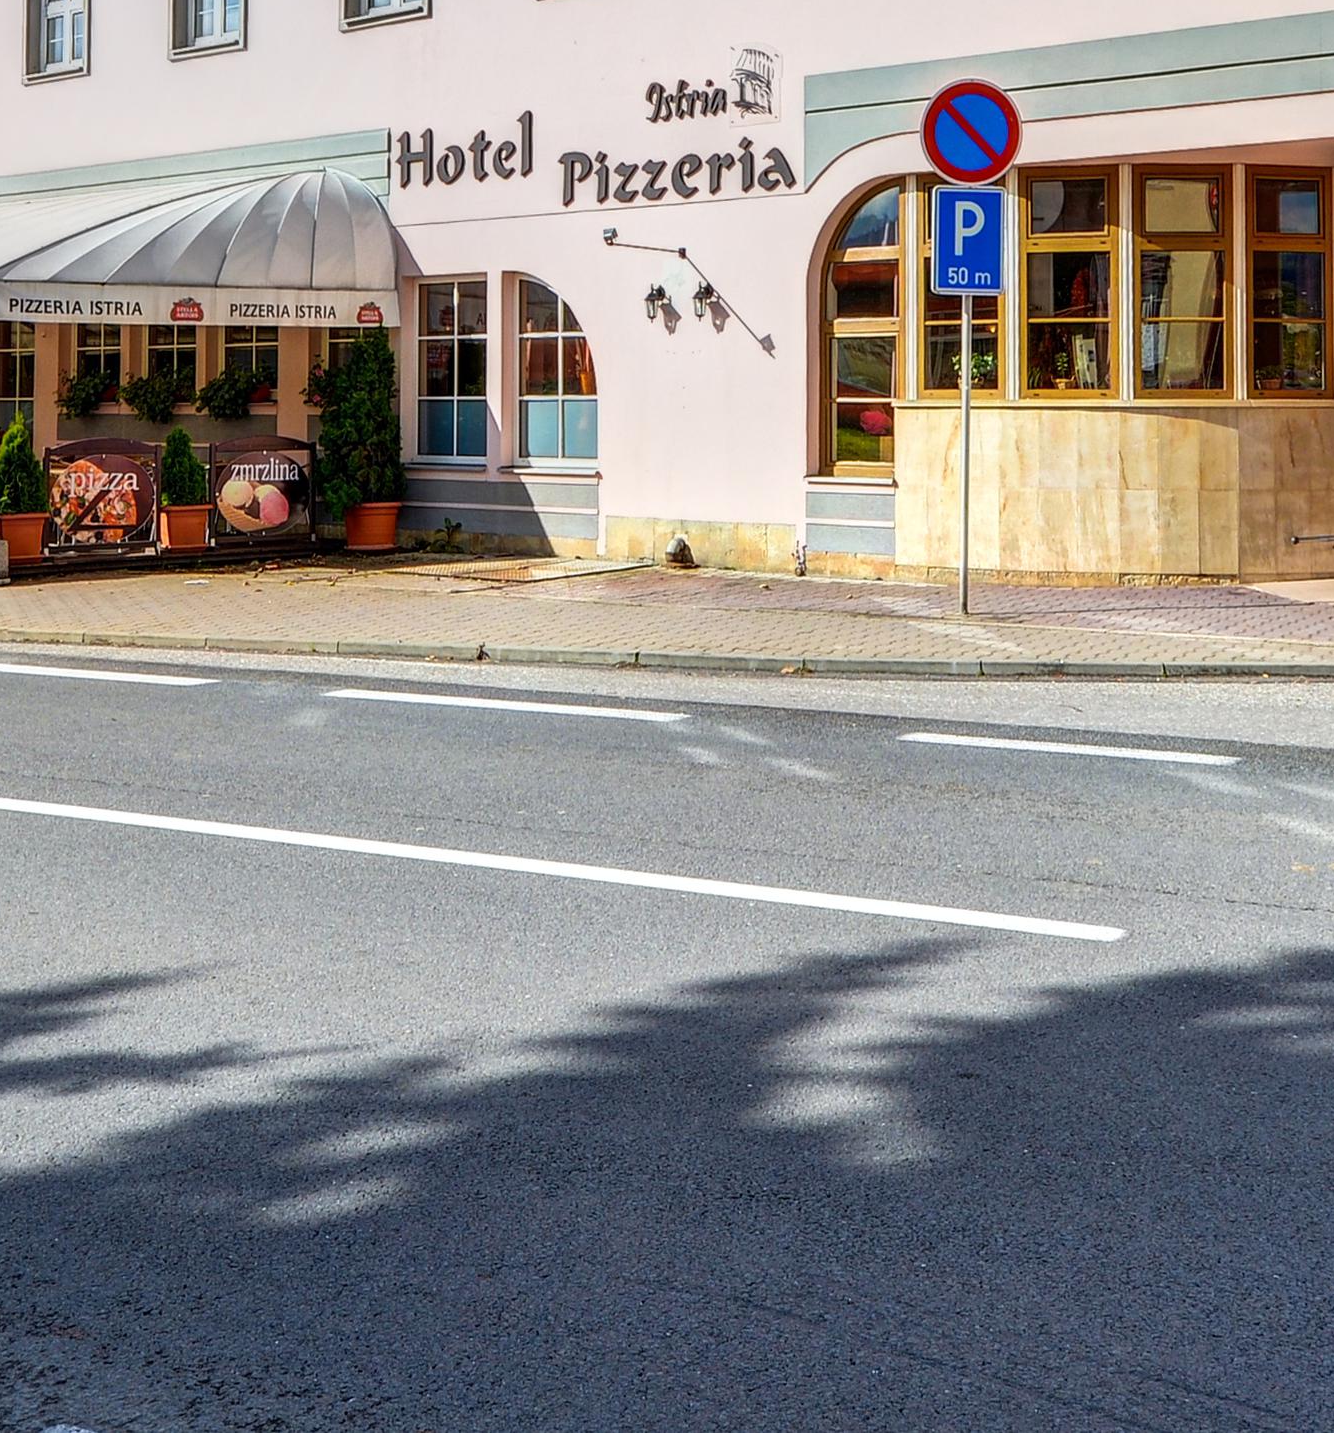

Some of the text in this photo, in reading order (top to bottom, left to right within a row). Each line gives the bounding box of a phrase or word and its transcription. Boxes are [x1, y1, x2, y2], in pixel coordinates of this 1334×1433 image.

[645, 79, 727, 123] Istria
[396, 109, 534, 190] Hotel
[557, 136, 798, 207] Pizzeria
[954, 200, 985, 257] P
[947, 267, 991, 285] 50 m
[8, 298, 143, 316] PIZZERIA ISTRIA
[229, 303, 337, 319] PIZZERIA ISTRIA
[68, 468, 140, 498] pizza
[230, 459, 299, 482] zmrzlina
